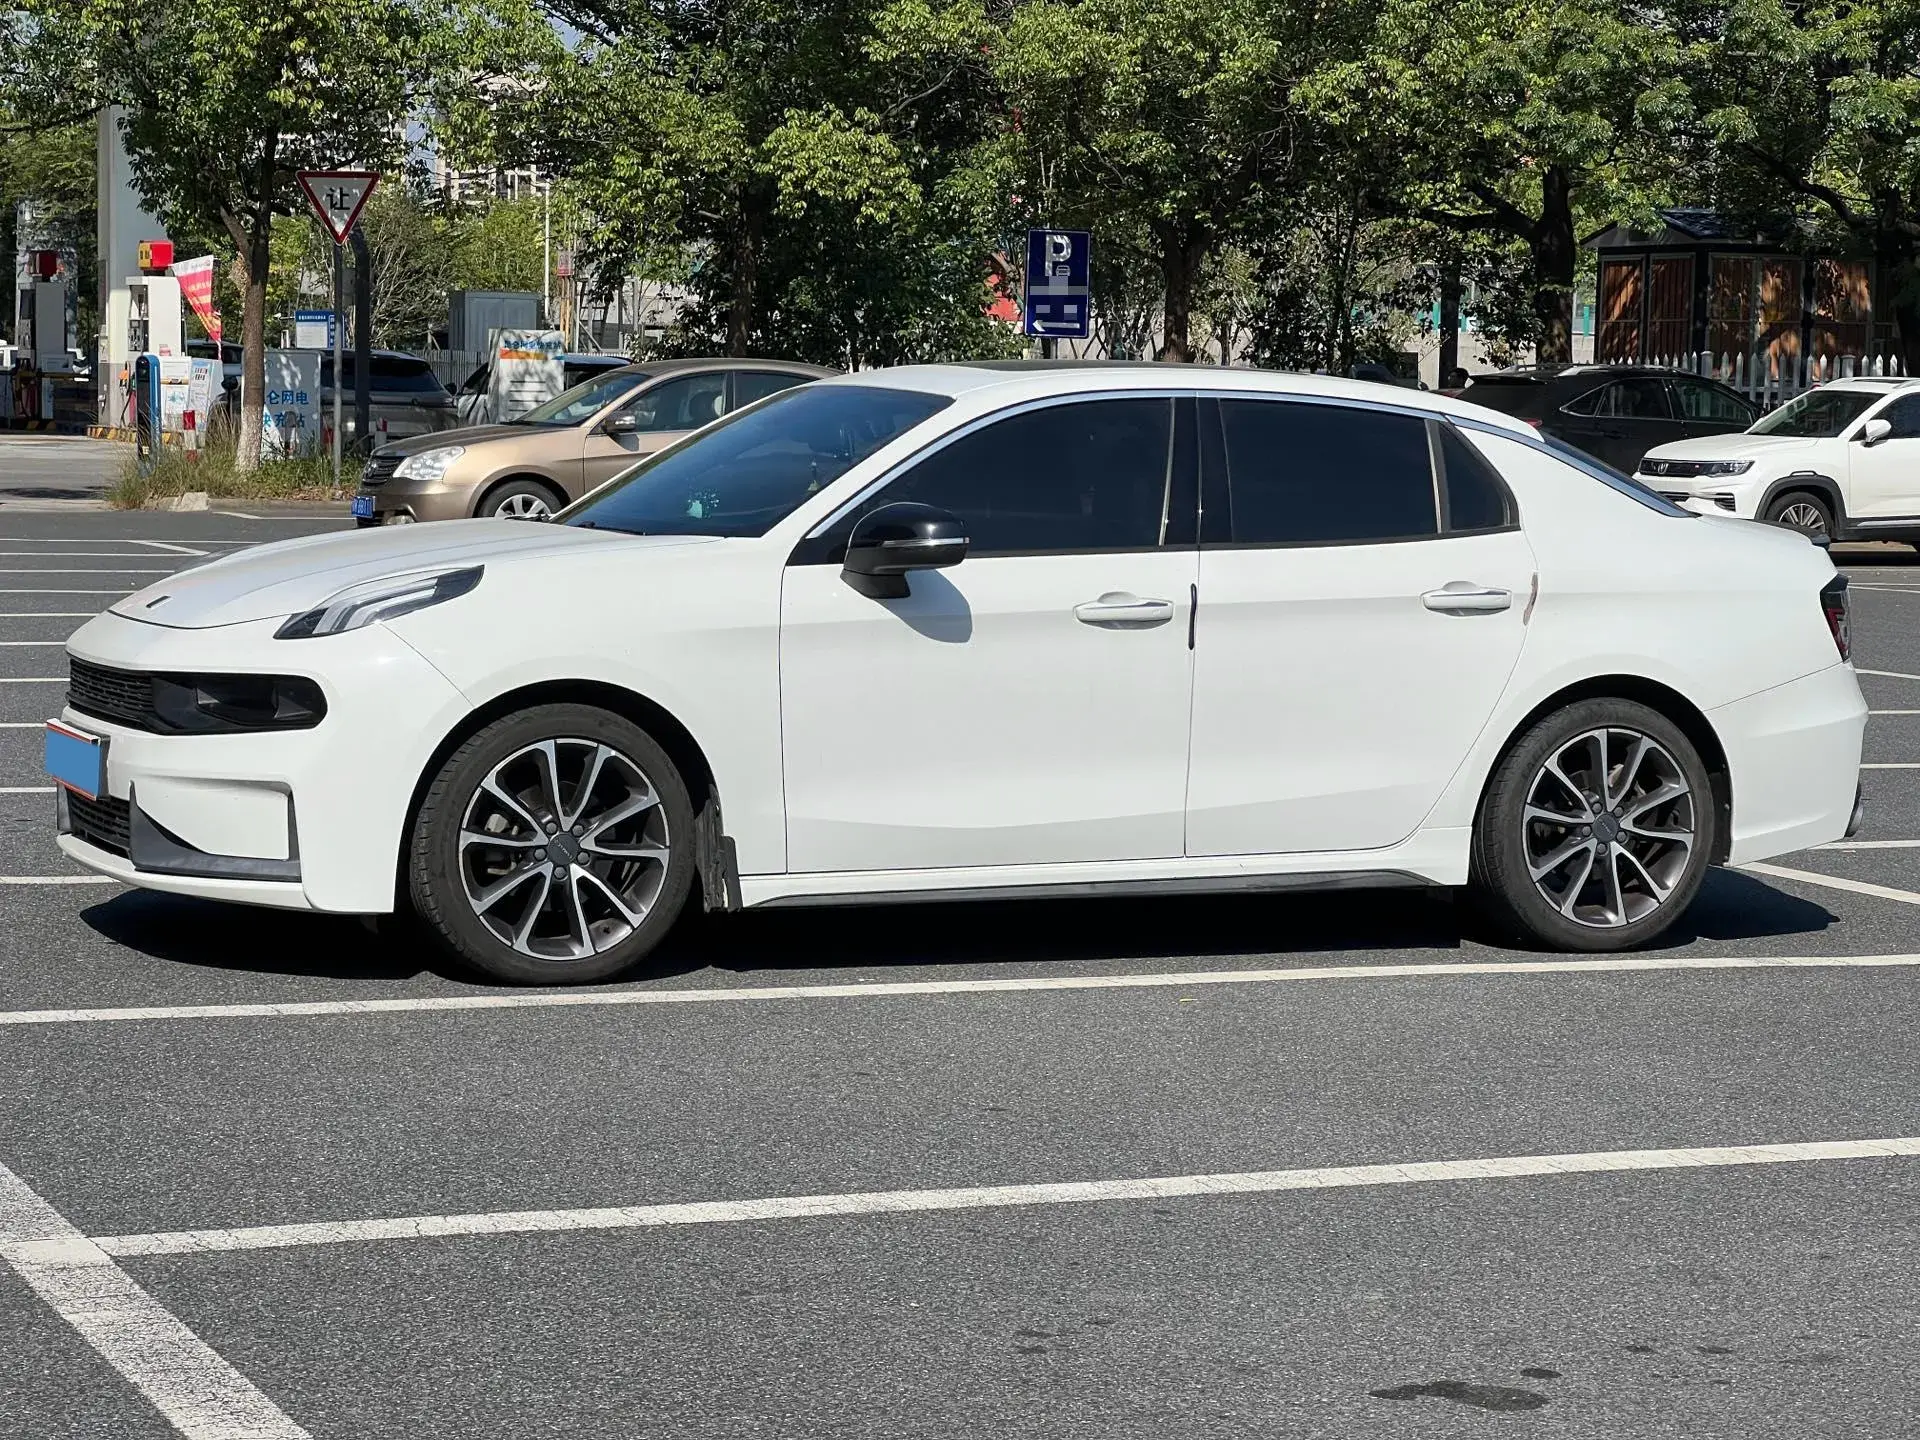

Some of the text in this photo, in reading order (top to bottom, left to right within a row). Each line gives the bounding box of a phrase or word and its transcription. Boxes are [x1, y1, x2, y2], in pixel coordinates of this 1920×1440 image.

[326, 187, 350, 210] 让
[1045, 234, 1072, 277] P
[265, 390, 309, 405] 仑网电
